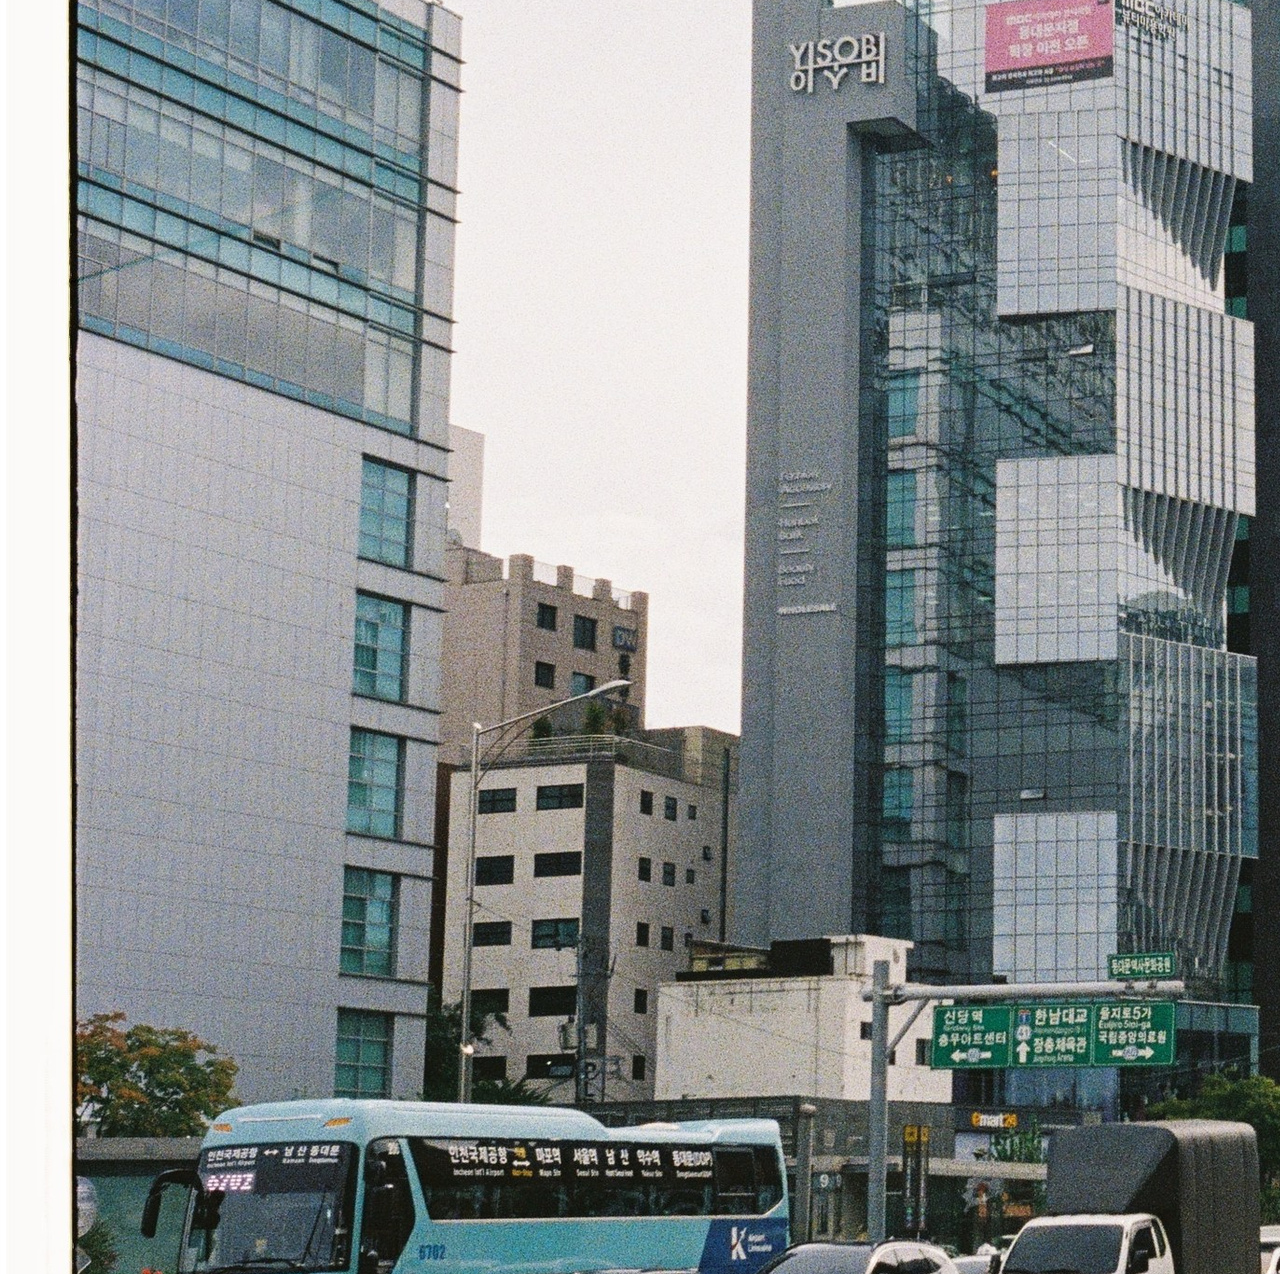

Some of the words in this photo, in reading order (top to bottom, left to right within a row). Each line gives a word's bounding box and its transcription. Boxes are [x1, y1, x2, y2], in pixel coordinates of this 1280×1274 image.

[789, 31, 885, 70] YISOBI
[944, 1009, 983, 1025] 신당역
[1035, 1008, 1088, 1026] 한남대교
[1099, 1006, 1152, 1020] 을지로5가
[938, 1031, 1007, 1047] 충무아트센터
[1033, 1036, 1088, 1053] 장충체육관
[1099, 1030, 1167, 1044] 국립중앙의료원
[208, 1147, 259, 1163] 인천국제공항
[309, 1145, 341, 1158] 동대문
[448, 1146, 508, 1165] 인천국제공항
[535, 1147, 562, 1165] 마포역
[573, 1147, 599, 1166] 서울역
